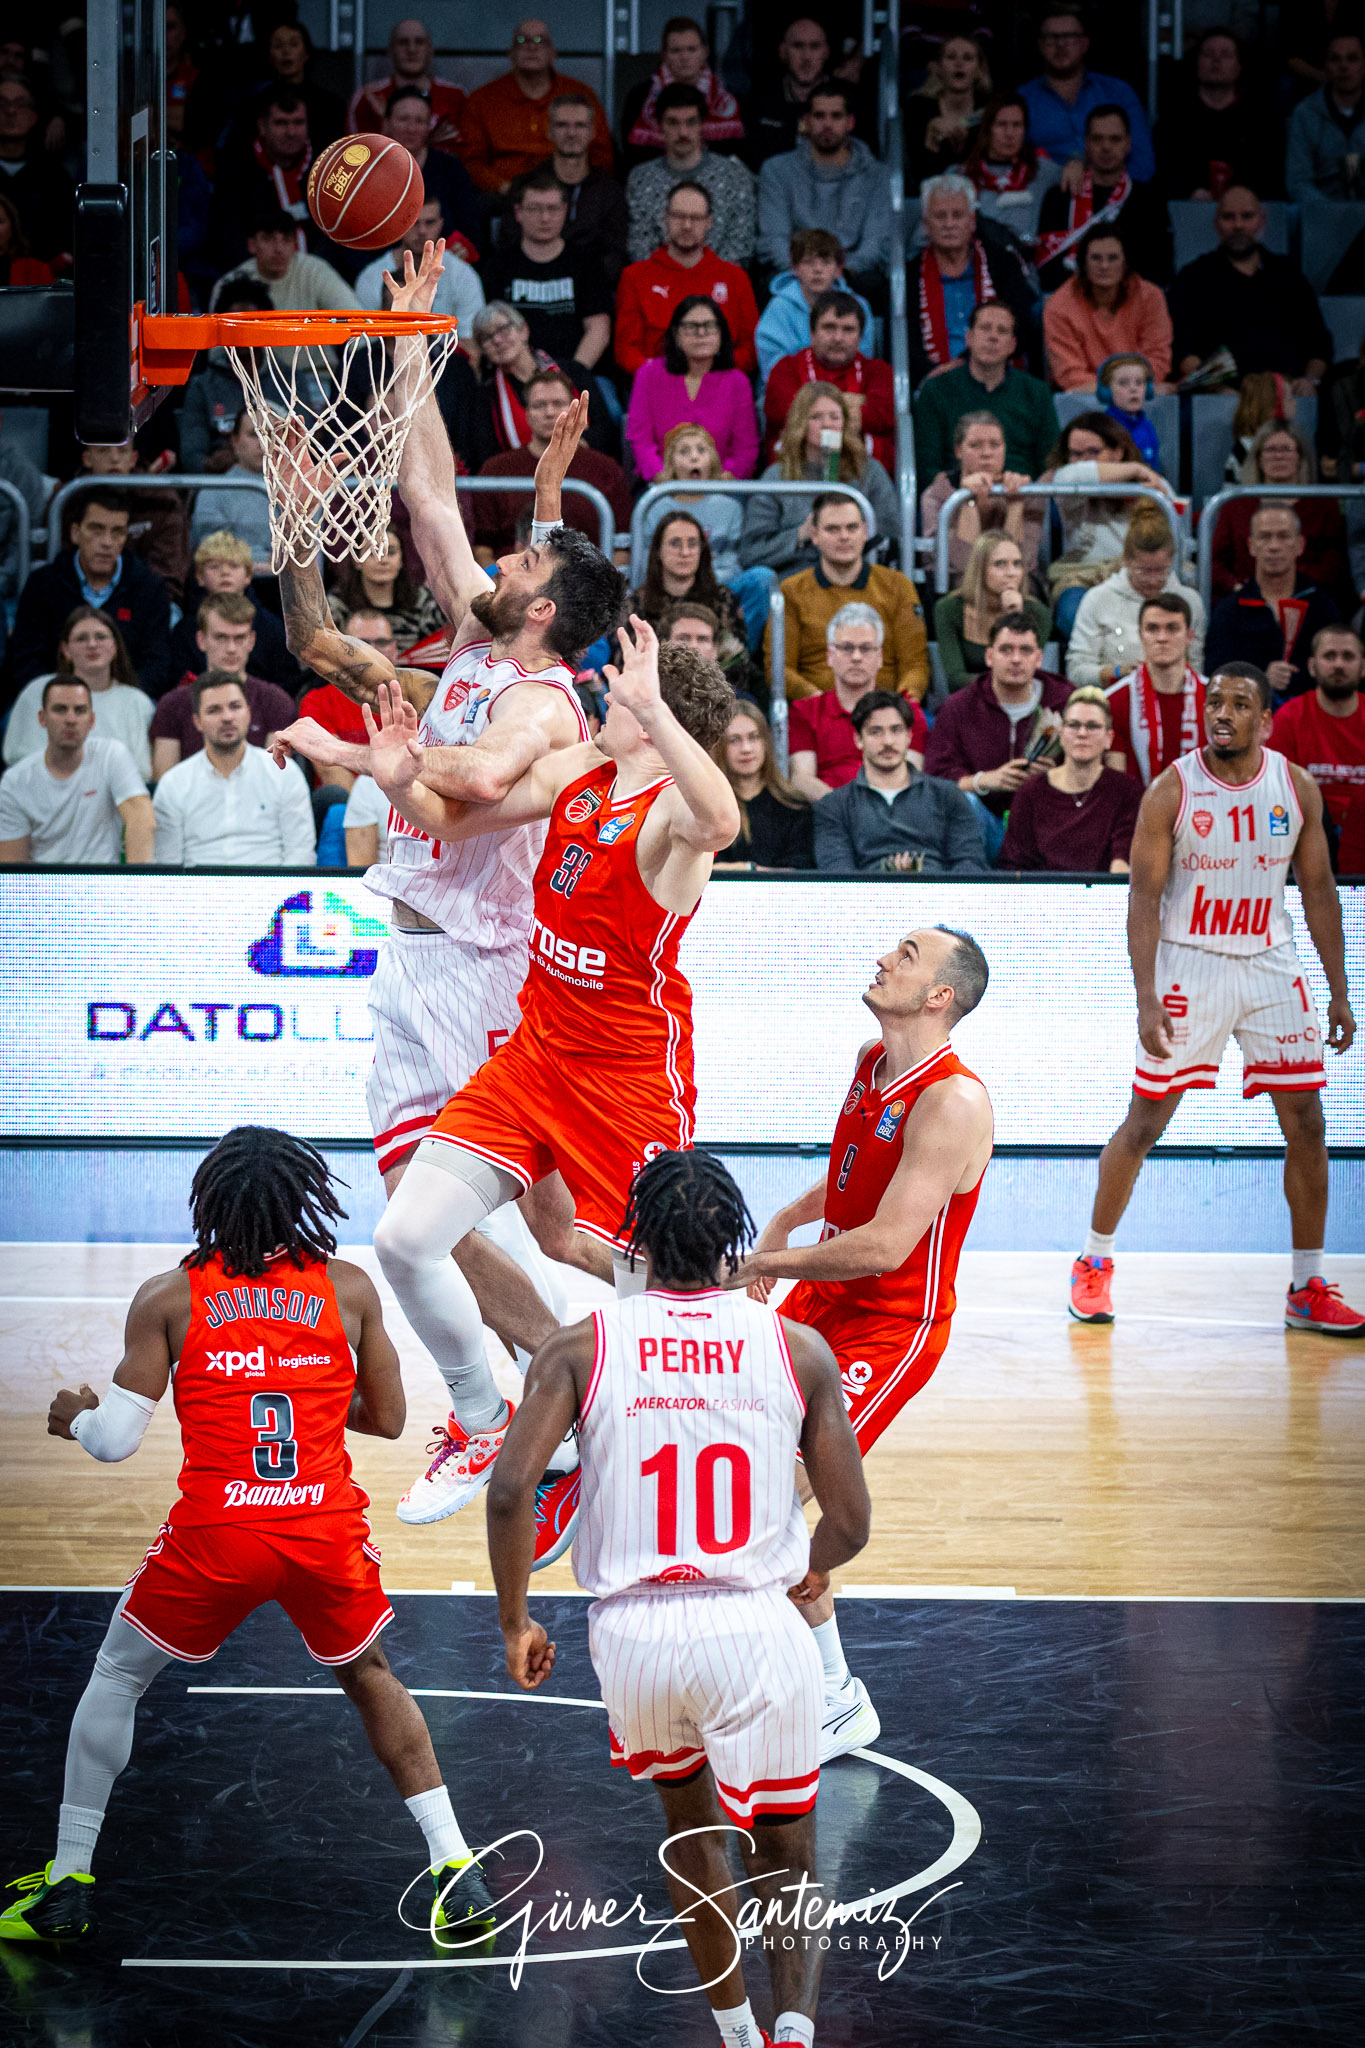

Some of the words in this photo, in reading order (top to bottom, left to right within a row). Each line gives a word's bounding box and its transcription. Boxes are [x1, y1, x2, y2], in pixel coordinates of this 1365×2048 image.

[308, 134, 356, 198] SPALD
[333, 171, 353, 196] BBL
[511, 277, 575, 303] PUMA
[1227, 804, 1256, 843] 11
[550, 843, 594, 900] 33
[1189, 885, 1273, 947] KNAU
[528, 915, 607, 977] rose
[546, 963, 604, 991] Automobile
[87, 1003, 375, 1041] DATOLU
[877, 1125, 892, 1139] BBL
[837, 1143, 858, 1192] 9
[204, 1286, 325, 1329] JOHNSON
[205, 1345, 265, 1376] xpd
[278, 1354, 331, 1369] logistics
[639, 1337, 745, 1374] PERRY
[244, 1371, 266, 1379] global
[251, 1392, 298, 1481] 3
[223, 1480, 325, 1508] Bamberg
[640, 1442, 751, 1556] 10
